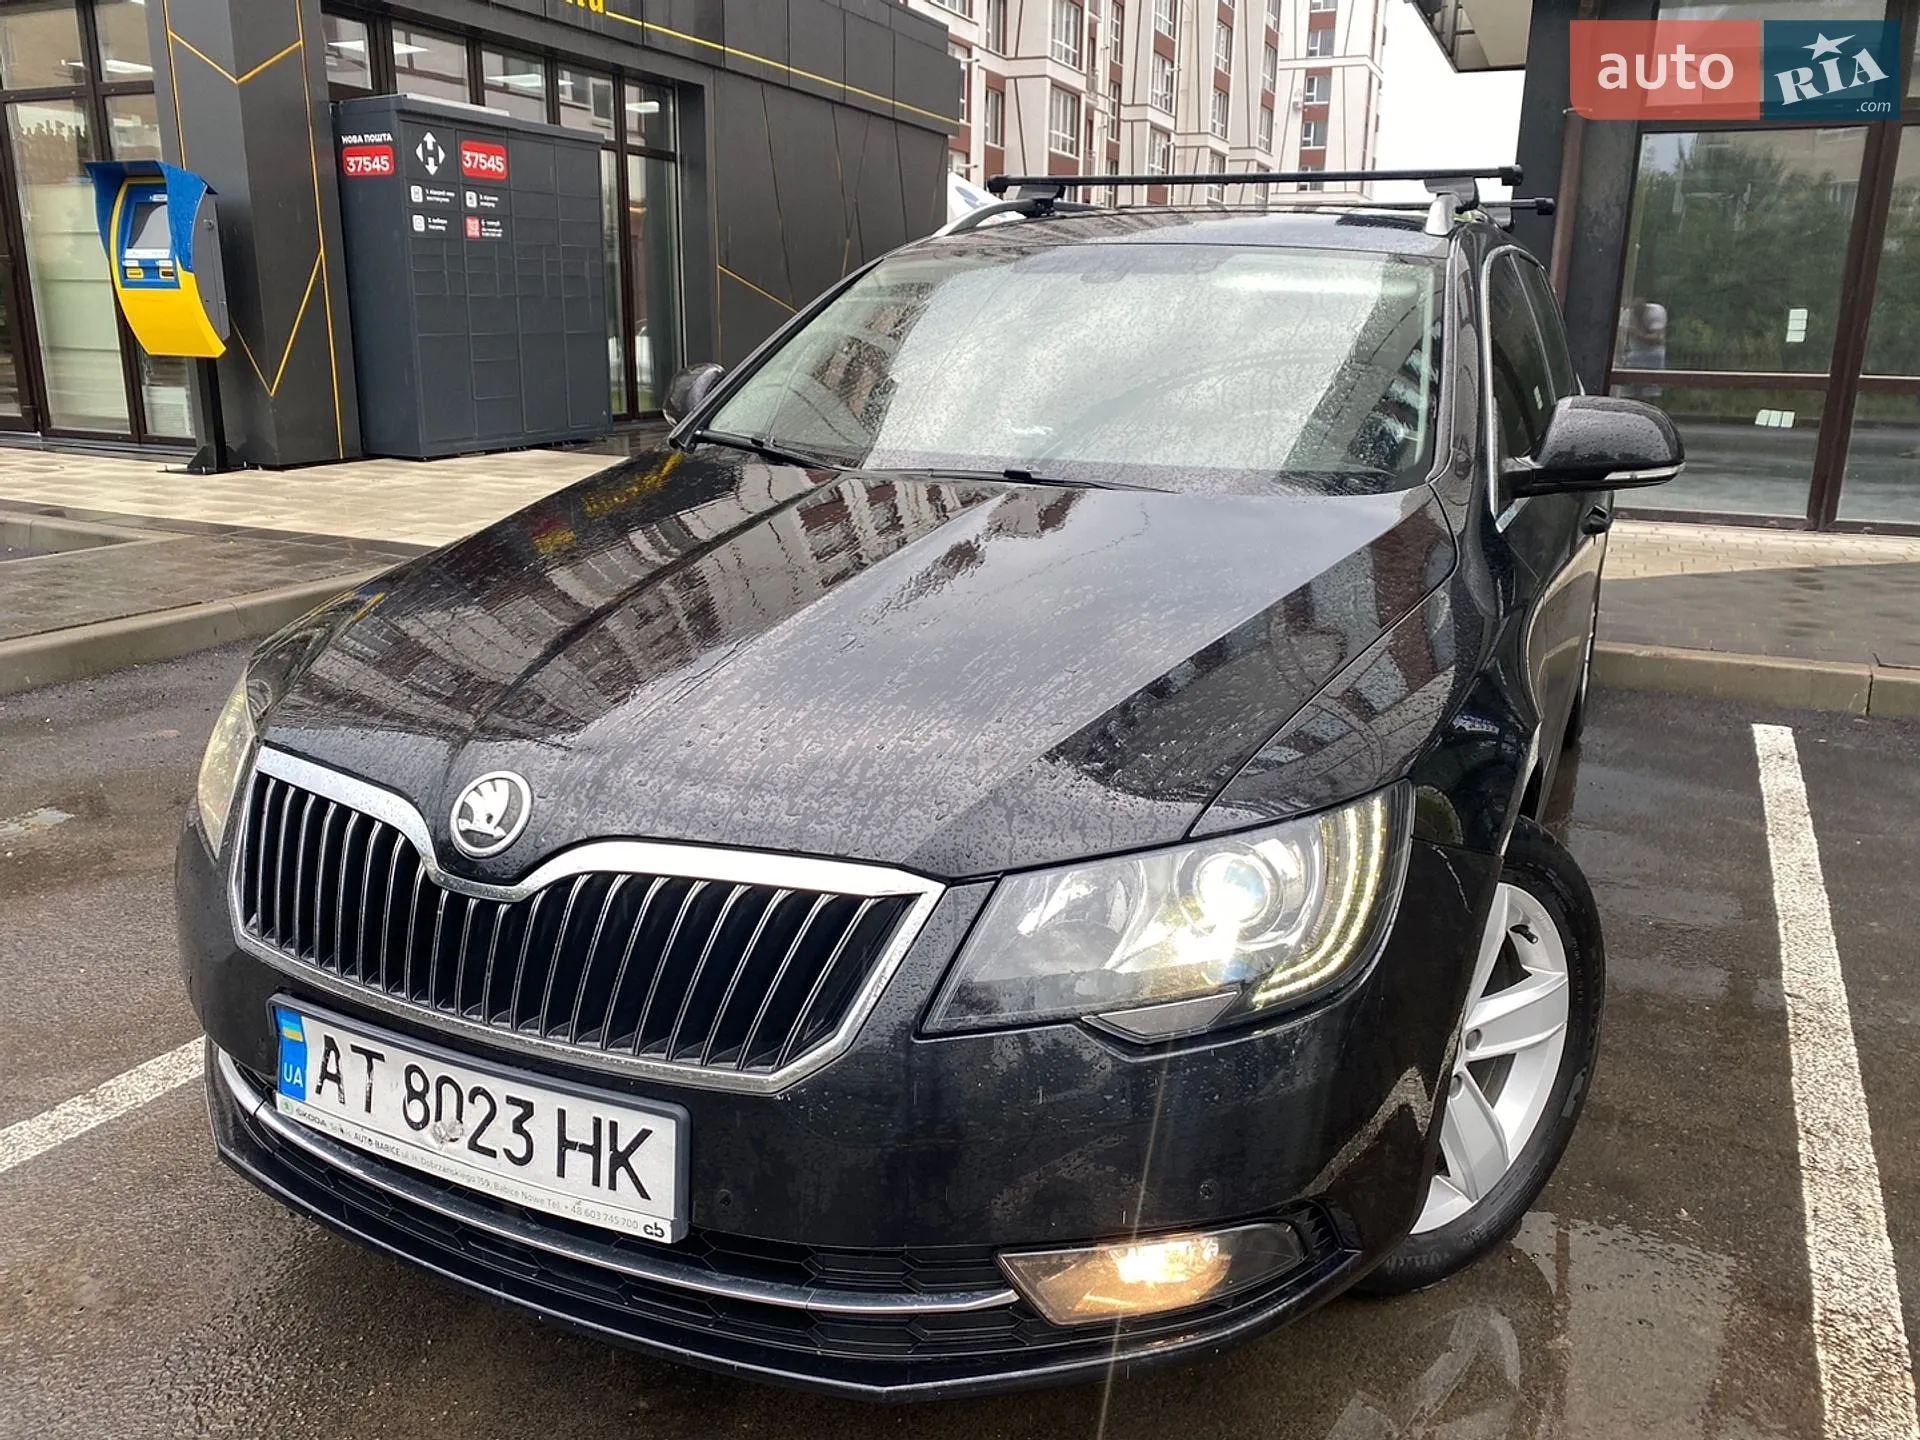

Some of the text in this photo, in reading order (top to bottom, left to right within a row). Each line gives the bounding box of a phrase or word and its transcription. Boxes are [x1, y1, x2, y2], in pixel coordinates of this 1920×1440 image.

[341, 133, 393, 144] НОВА ПОШТА
[346, 155, 389, 172] 37545
[462, 150, 505, 173] 37545
[283, 1062, 304, 1087] UA
[315, 1034, 653, 1200] AT 8023 HK
